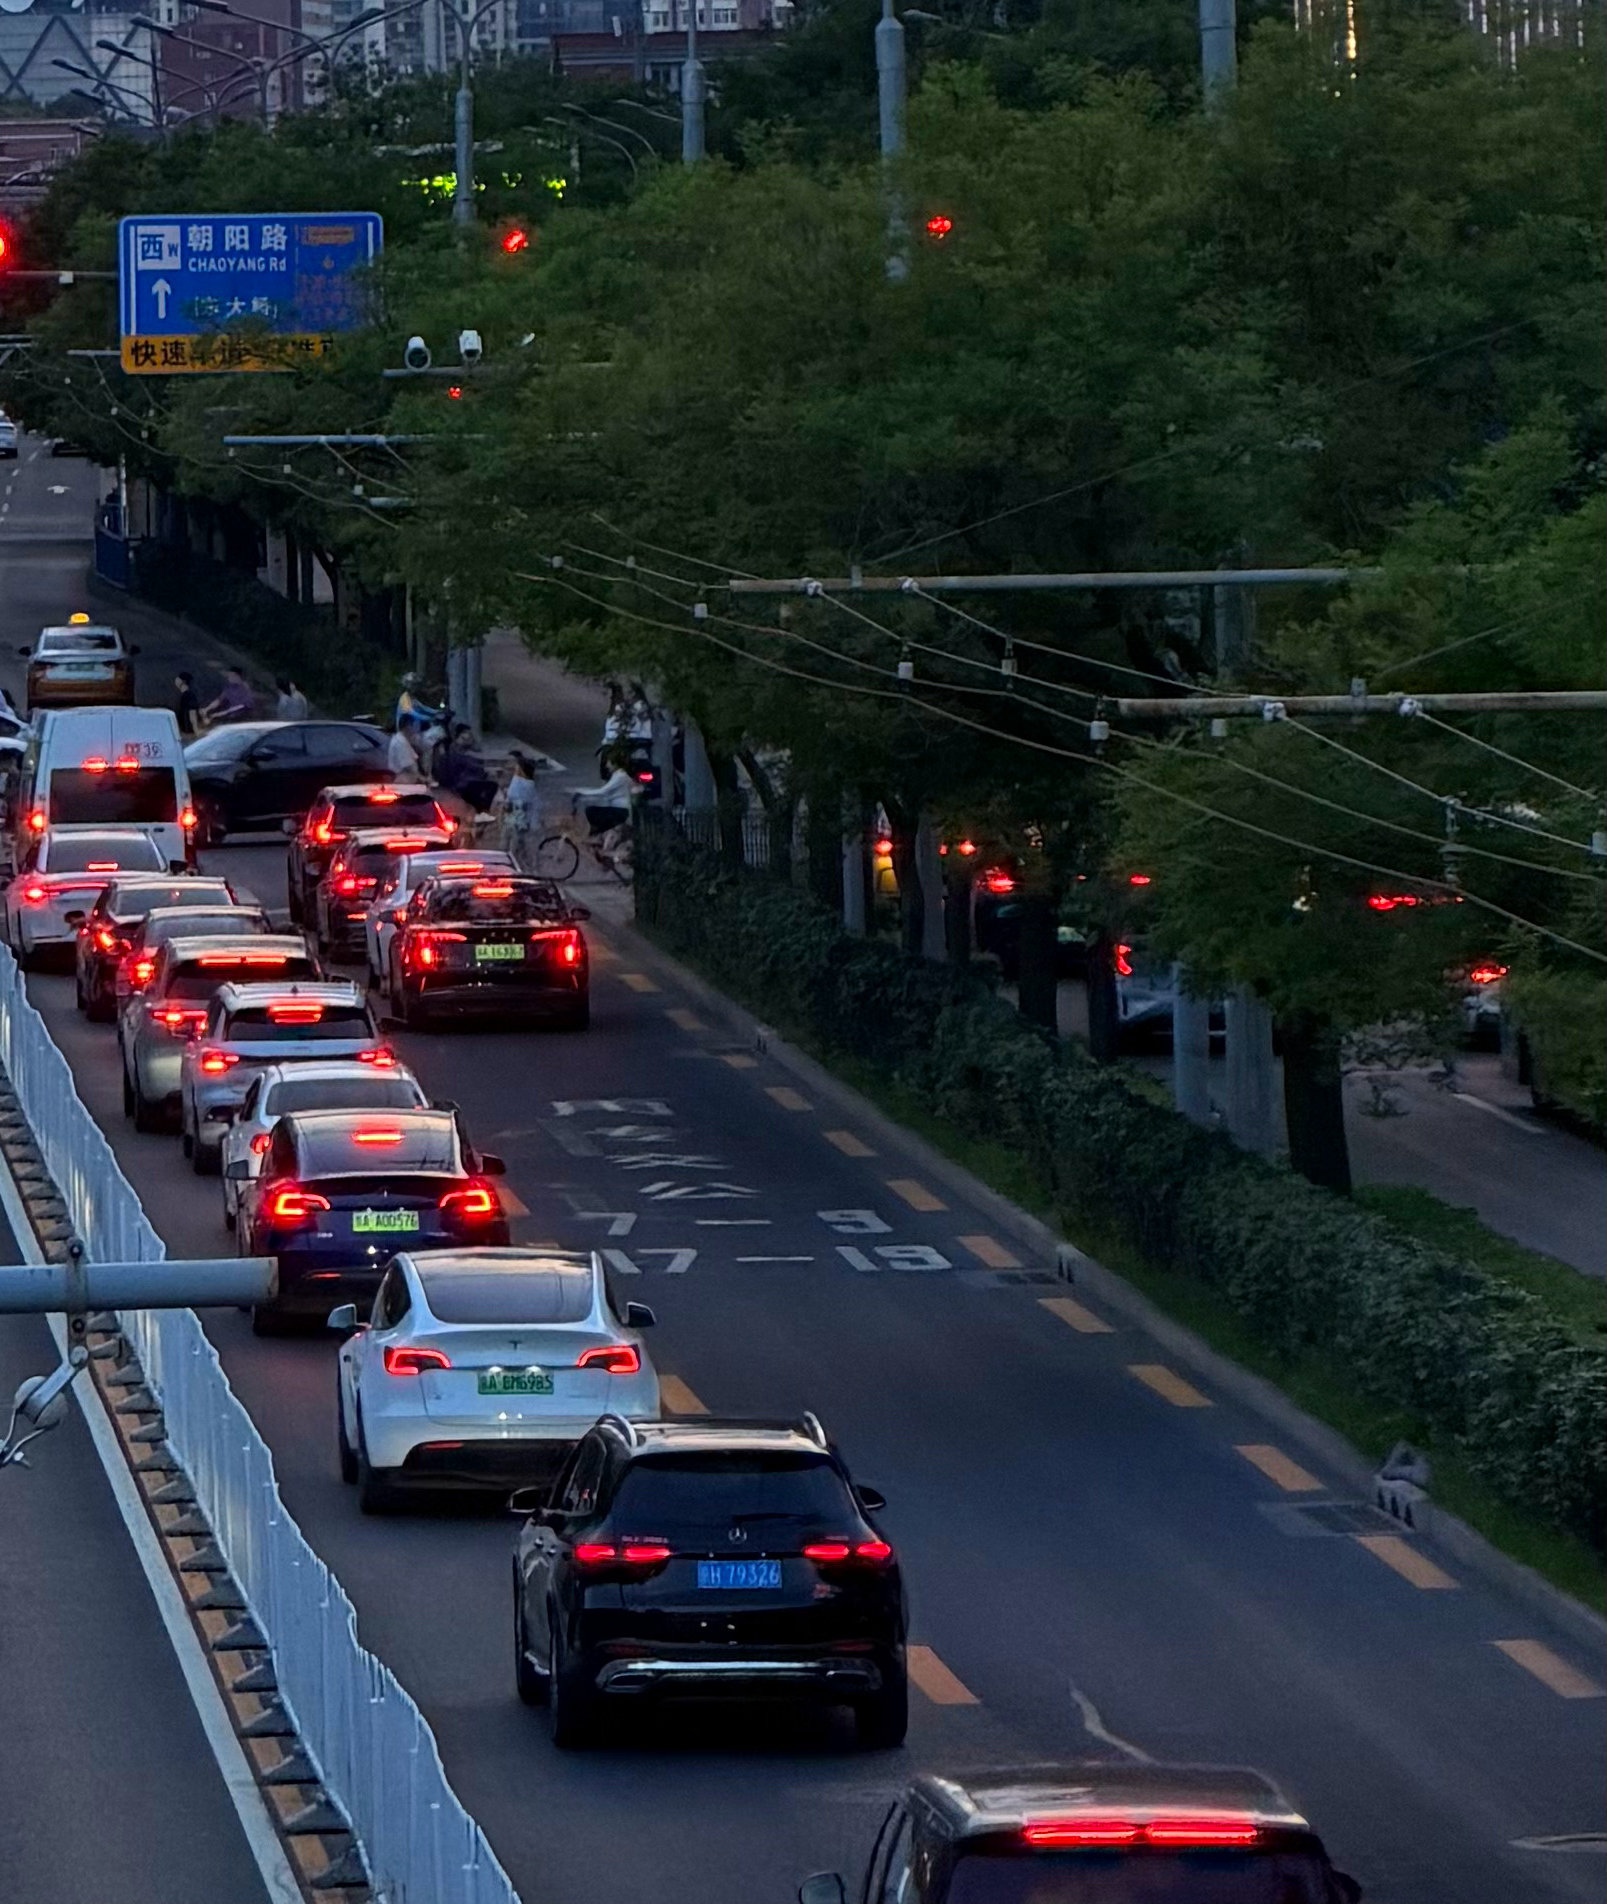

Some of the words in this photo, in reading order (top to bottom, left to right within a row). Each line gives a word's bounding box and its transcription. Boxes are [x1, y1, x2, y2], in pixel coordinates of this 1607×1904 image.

[140, 233, 165, 262] 西
[167, 240, 179, 256] W
[187, 223, 289, 252] 朝阳路
[188, 256, 265, 273] CHAOYANG
[269, 256, 287, 272] Rd
